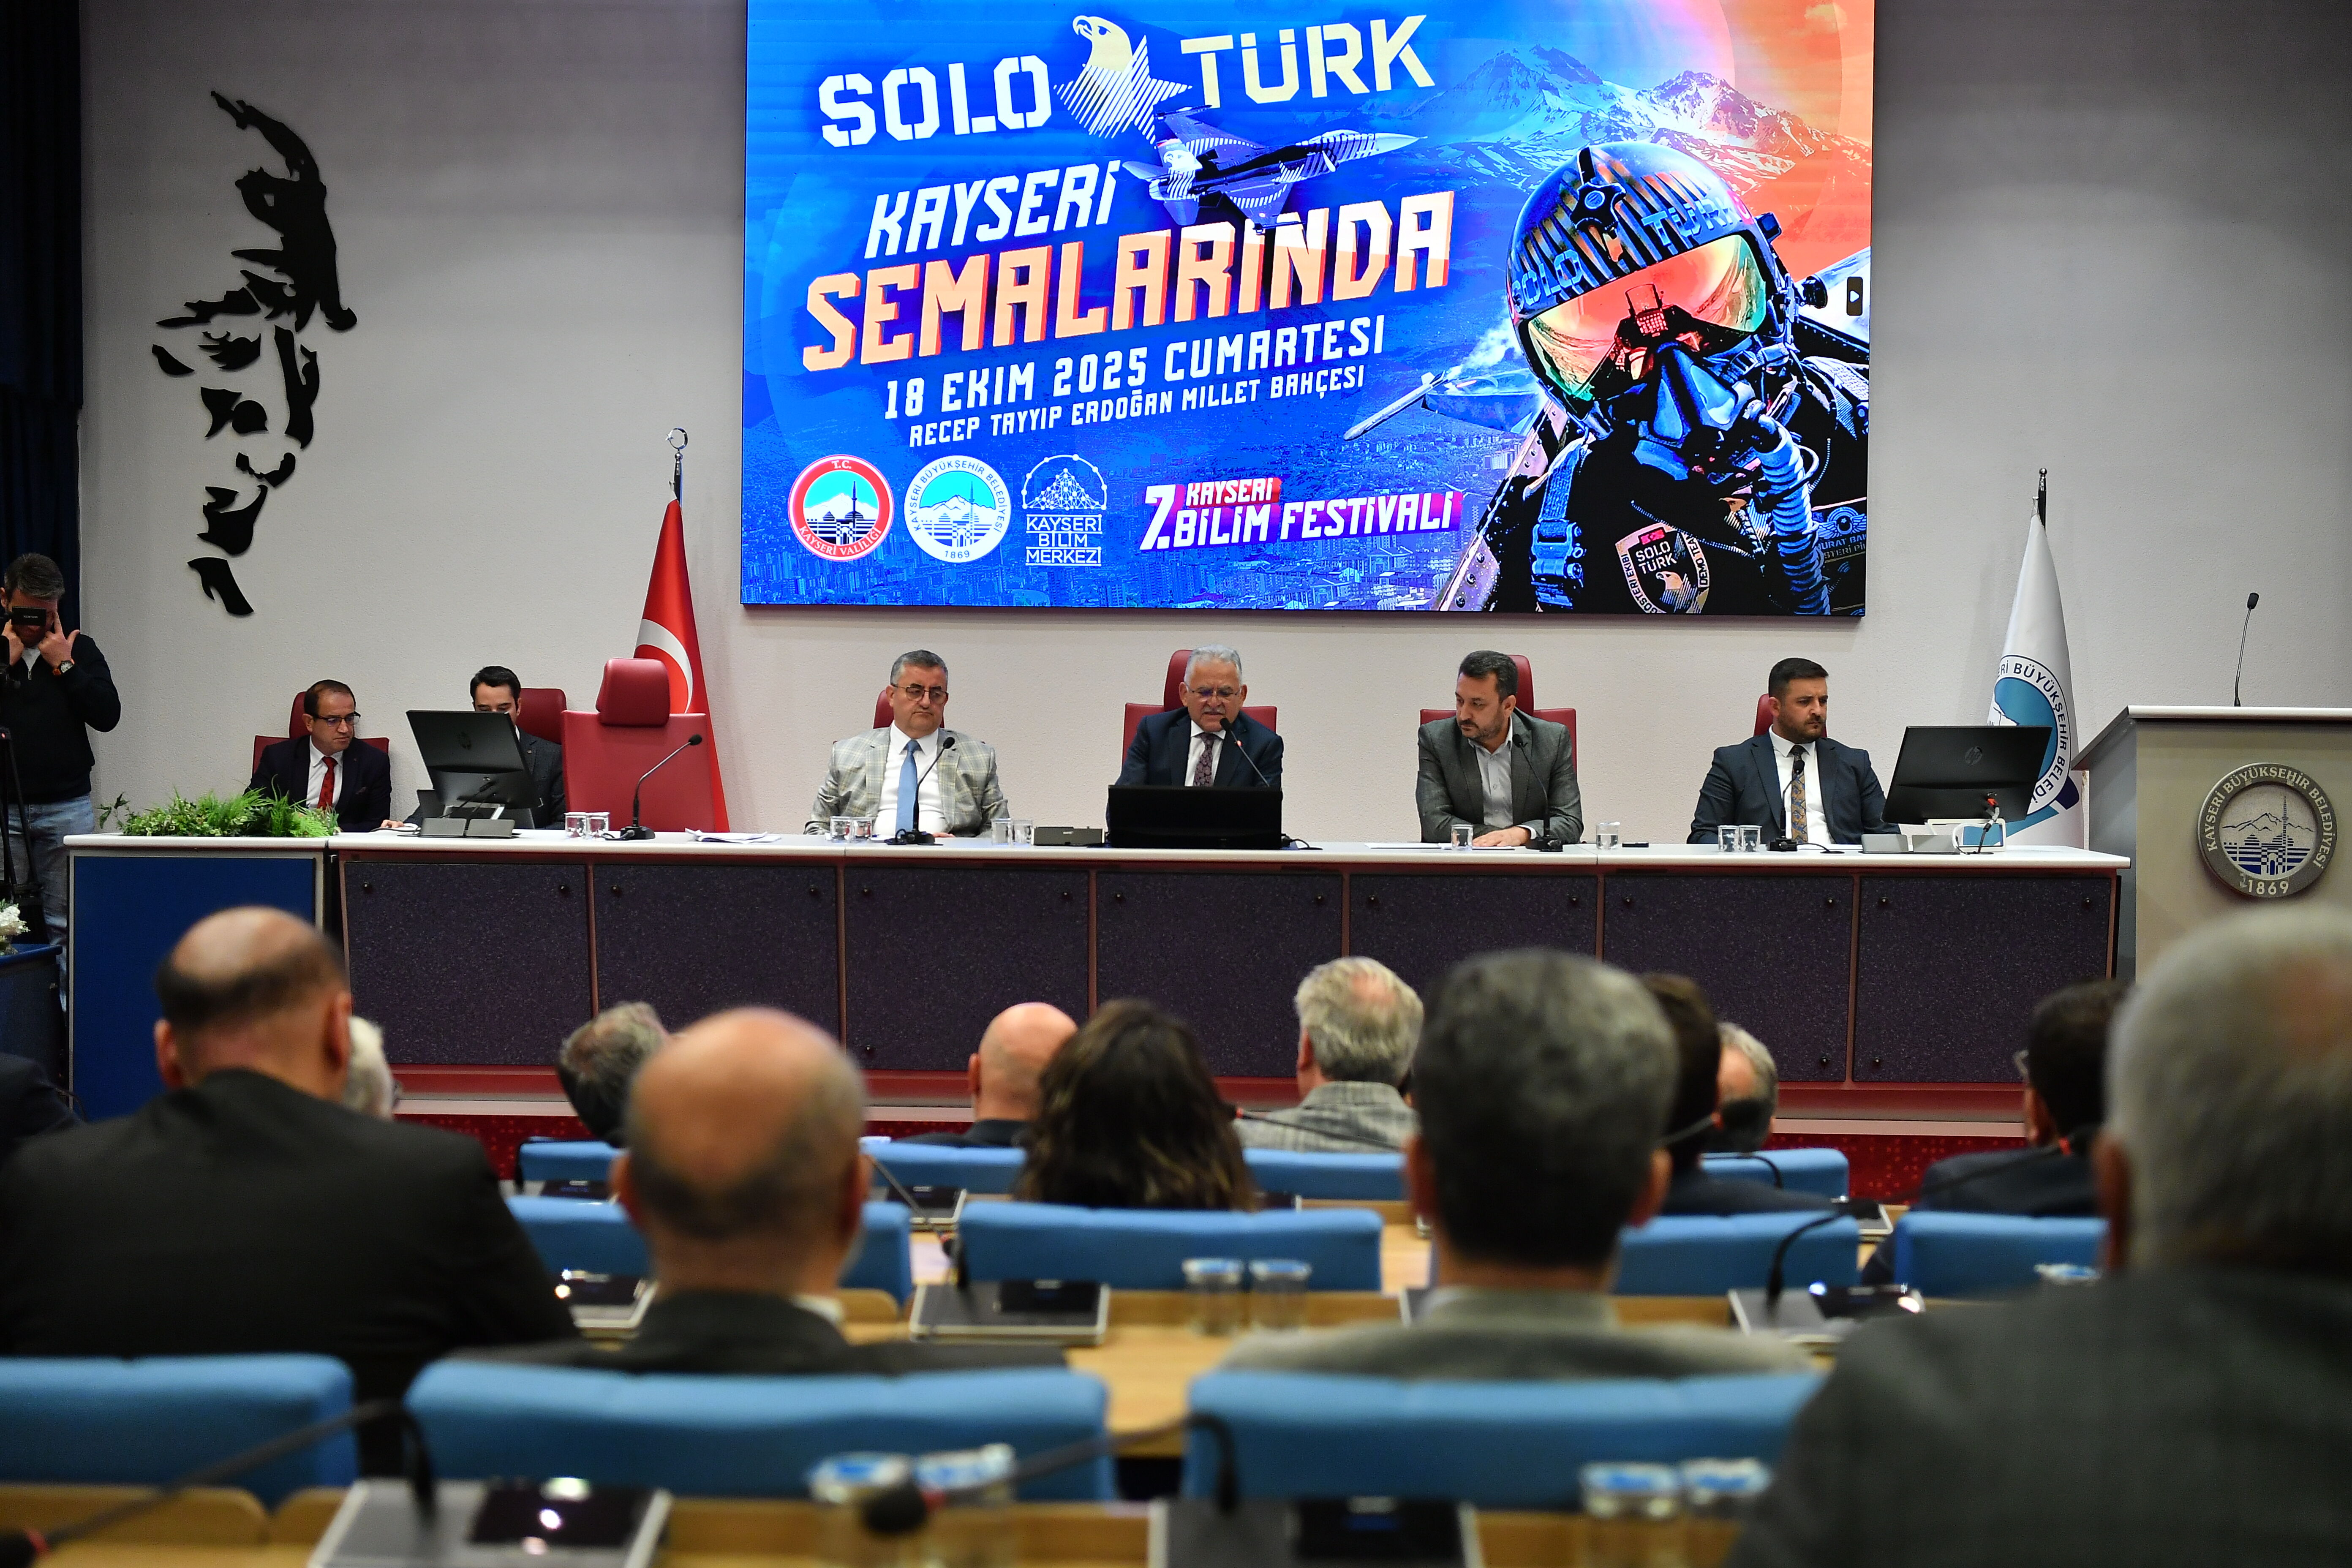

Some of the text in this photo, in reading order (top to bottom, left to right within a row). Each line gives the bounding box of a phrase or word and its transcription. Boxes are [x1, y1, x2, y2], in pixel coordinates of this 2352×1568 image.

[818, 15, 1435, 147] SOLO TÜRK
[865, 160, 1121, 259] KAYSERİ
[1512, 197, 1742, 313] SOLO TÜRK
[803, 191, 1454, 371] SEMALARINDA
[885, 378, 925, 419] 18
[1053, 347, 1148, 397] 2025
[909, 416, 980, 447] RECEP
[991, 406, 1062, 436] TAYYIP
[1071, 389, 1173, 425] ERDOĞAN
[831, 460, 852, 469] T.C.
[910, 484, 922, 531] KAYSERİ
[920, 460, 985, 484] BÜYÜKŞEHİR
[1186, 477, 1274, 506] KAYSERİ
[1026, 514, 1102, 531] KAYSERİ
[1140, 485, 1454, 550] 7. BİLİM FESTİVALİ
[799, 525, 836, 555] KAYSERİ
[1038, 531, 1088, 547] BİLİM
[1636, 541, 1670, 561] SOLO
[1823, 545, 1851, 558] STERİ
[945, 550, 970, 559] 1869
[1026, 547, 1102, 564] MERKEZİ
[1638, 553, 1677, 574] TÜRK
[1696, 558, 1708, 585] DEMO
[2013, 663, 2068, 751] BÜYÜKŞEHİR
[2205, 766, 2336, 869] KAYSERİ BÜYÜKŞEHİR BELEDİYESİ
[2248, 879, 2289, 895] 1869
